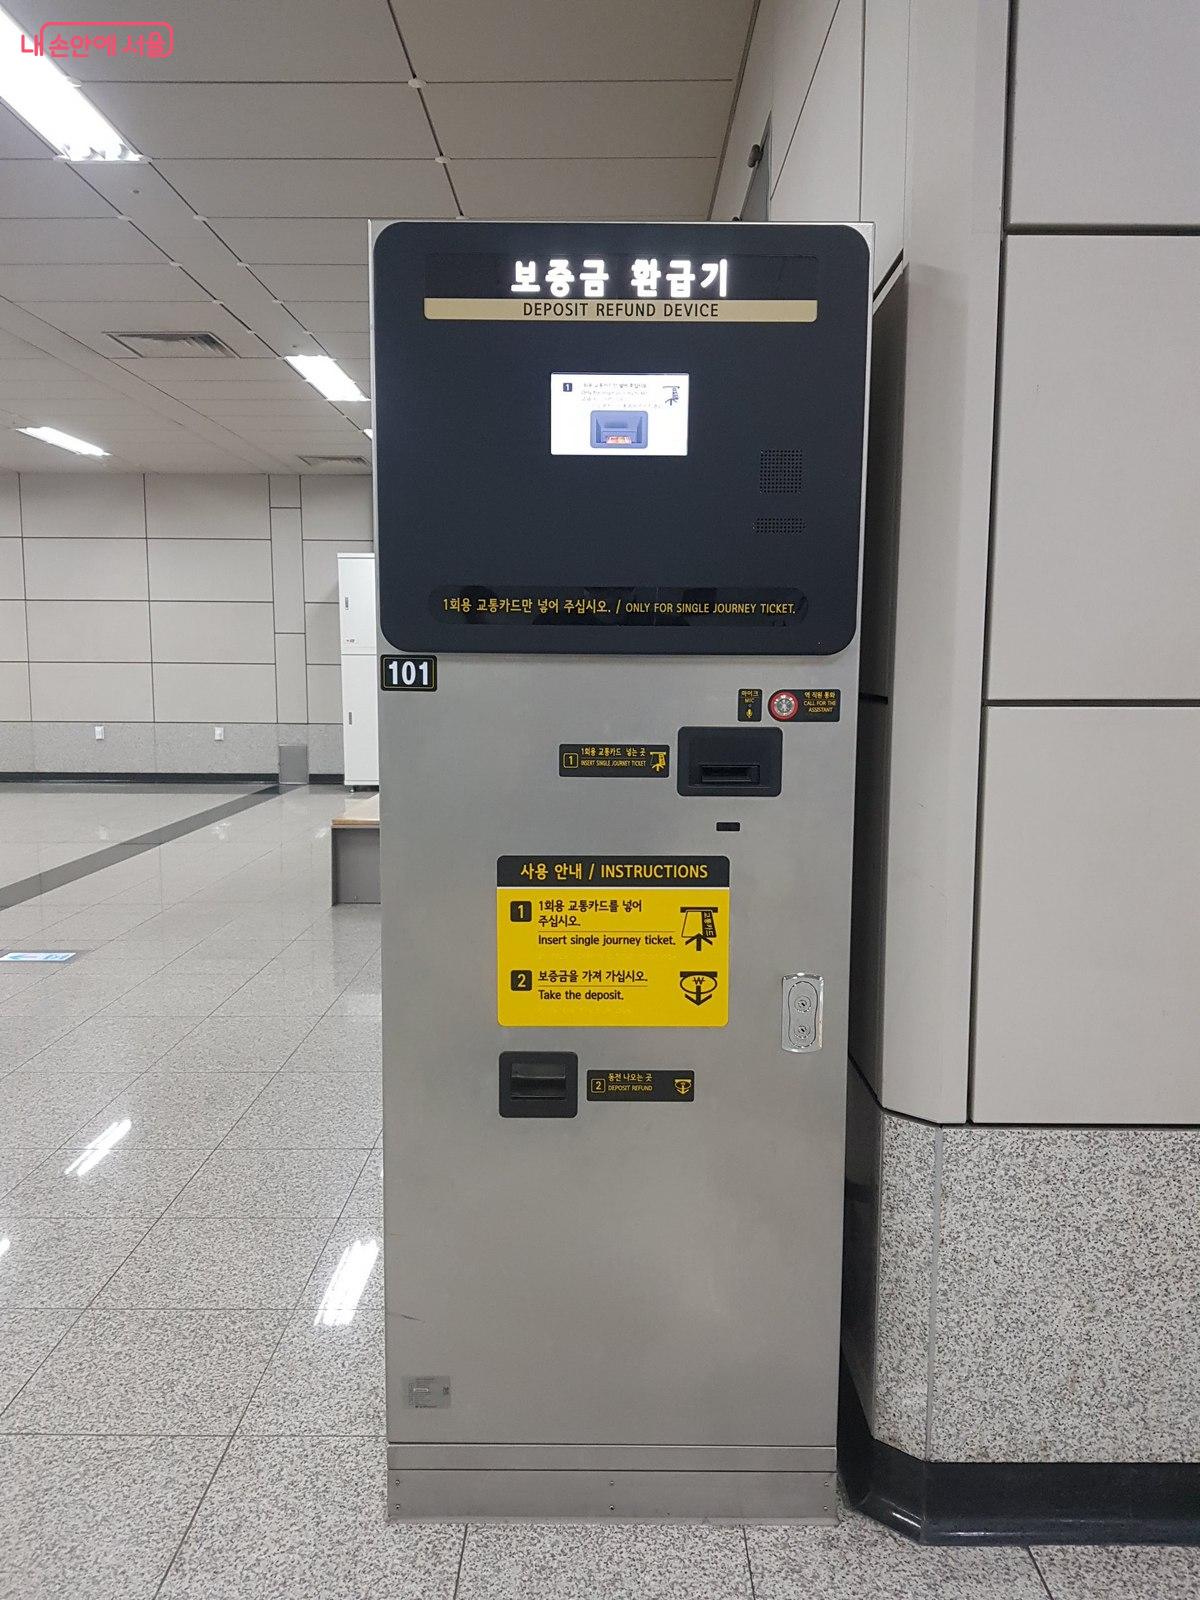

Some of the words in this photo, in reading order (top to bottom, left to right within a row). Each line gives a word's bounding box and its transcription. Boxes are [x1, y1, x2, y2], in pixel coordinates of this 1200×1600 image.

[511, 259, 609, 298] 보증금
[630, 258, 728, 298] 환급기
[523, 302, 588, 317] DEPOSIT
[596, 302, 656, 317] REFUND
[663, 302, 718, 317] DEVICE
[443, 597, 472, 613] 1회용
[476, 597, 533, 613] 교통카드만
[538, 598, 559, 614] 넣어
[563, 598, 611, 614] 주십시오.
[625, 602, 650, 613] ONLY
[654, 602, 673, 613] FOR
[676, 603, 709, 614] SINGLE
[713, 603, 756, 614] JOURNEY
[760, 603, 796, 614] TICKET.
[389, 661, 428, 685] 101
[581, 747, 596, 757] 1회용
[598, 747, 621, 757] 교통카드
[626, 748, 637, 757] 넣는
[640, 748, 646, 757] 곳
[568, 756, 573, 765] 1
[520, 862, 548, 880] 사용
[554, 862, 582, 880] 안내
[601, 864, 708, 879] INSTRUCTIONS
[517, 904, 525, 919] 1
[538, 900, 565, 912] 1회용
[568, 900, 619, 913] 교통카드를
[622, 900, 642, 913] 넣어
[538, 915, 581, 927] 주십시오.
[538, 934, 567, 945] Insert
[570, 934, 599, 947] single
[601, 934, 641, 947] journey
[644, 934, 676, 946] ticket.
[517, 973, 526, 988] 2
[538, 970, 578, 983] 보증금을
[582, 970, 602, 983] 가져
[605, 970, 648, 983] 가십시오.
[538, 990, 561, 1000] Take
[565, 990, 581, 1000] the
[585, 990, 624, 1001] deposit.
[608, 1073, 622, 1082] 동전
[623, 1073, 644, 1082] 나오는
[645, 1073, 653, 1082] 곳
[595, 1081, 602, 1090] 2
